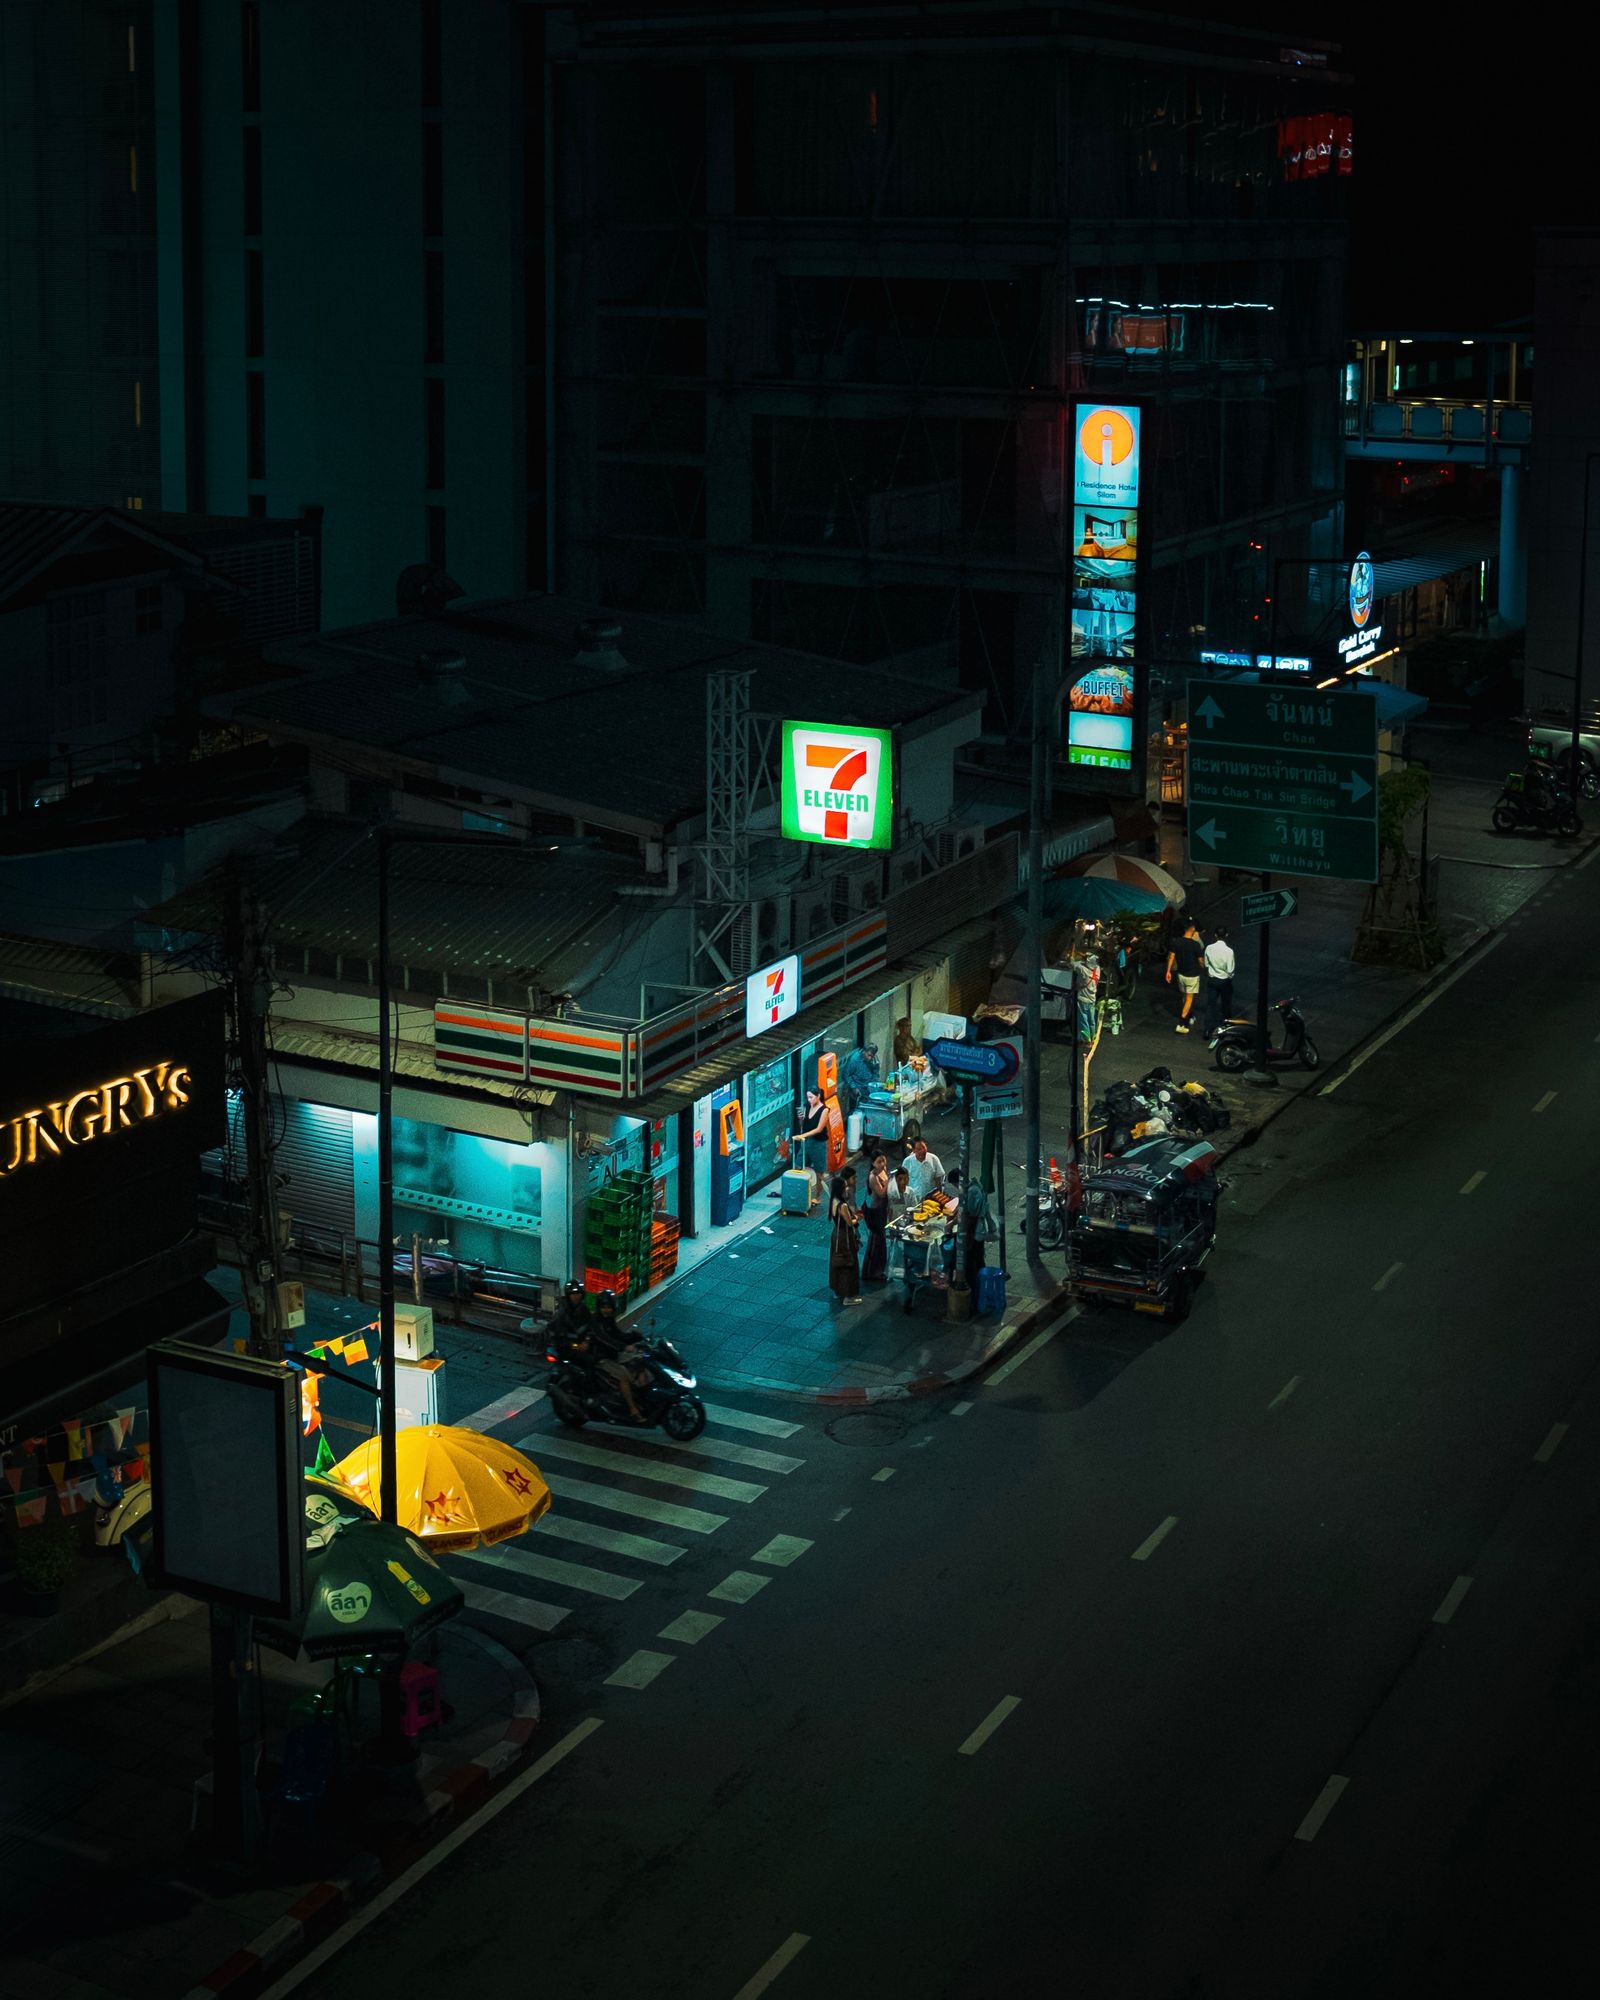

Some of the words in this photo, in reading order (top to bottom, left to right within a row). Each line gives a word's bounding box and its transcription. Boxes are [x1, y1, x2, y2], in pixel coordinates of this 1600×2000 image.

[1080, 481, 1116, 490] Residence
[1118, 483, 1137, 491] Hotel
[1097, 491, 1117, 499] Silom
[1083, 680, 1123, 697] BUFFET
[1265, 692, 1336, 727] จันทน์
[1282, 731, 1316, 744] Chan
[806, 744, 868, 839] 7
[1193, 783, 1218, 796] Phra
[1222, 785, 1250, 799] Chao
[1279, 792, 1296, 805] Sin
[1300, 794, 1337, 809] Bridge
[1273, 817, 1326, 857] วิทยุ
[766, 968, 784, 1024] 7
[988, 1052, 996, 1067] 3
[331, 1593, 368, 1611] ลีลา
